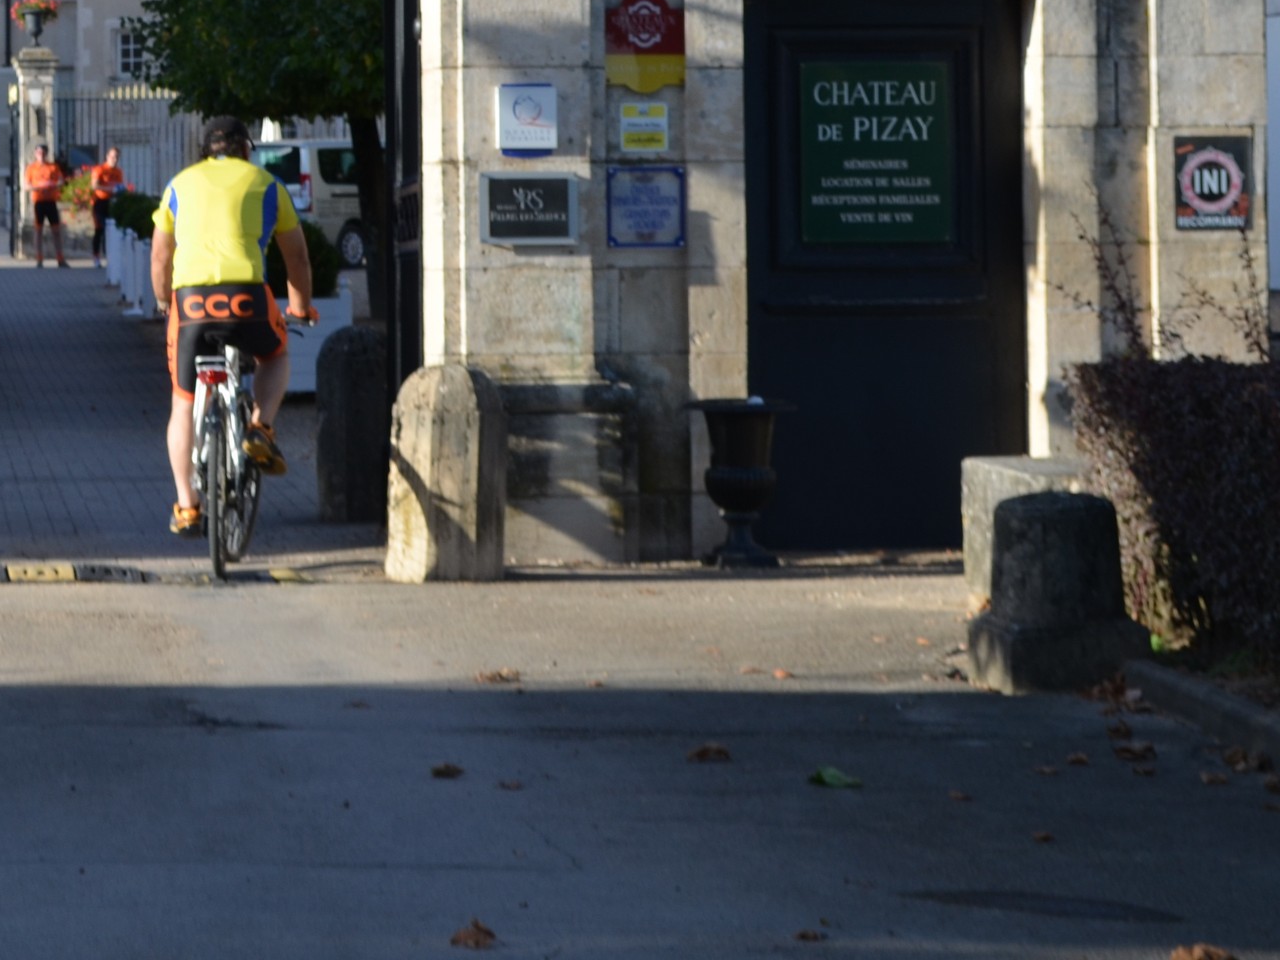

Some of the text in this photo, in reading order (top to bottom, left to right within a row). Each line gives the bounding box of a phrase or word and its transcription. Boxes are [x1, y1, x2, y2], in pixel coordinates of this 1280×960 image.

[813, 81, 936, 106] CHATEAU
[818, 116, 933, 141] DE PIZAY
[822, 177, 931, 188] LOCATION DE SALLES
[879, 195, 940, 206] FAMILIALES
[840, 212, 914, 223] VENTE DE VIN
[183, 293, 254, 319] CCC
